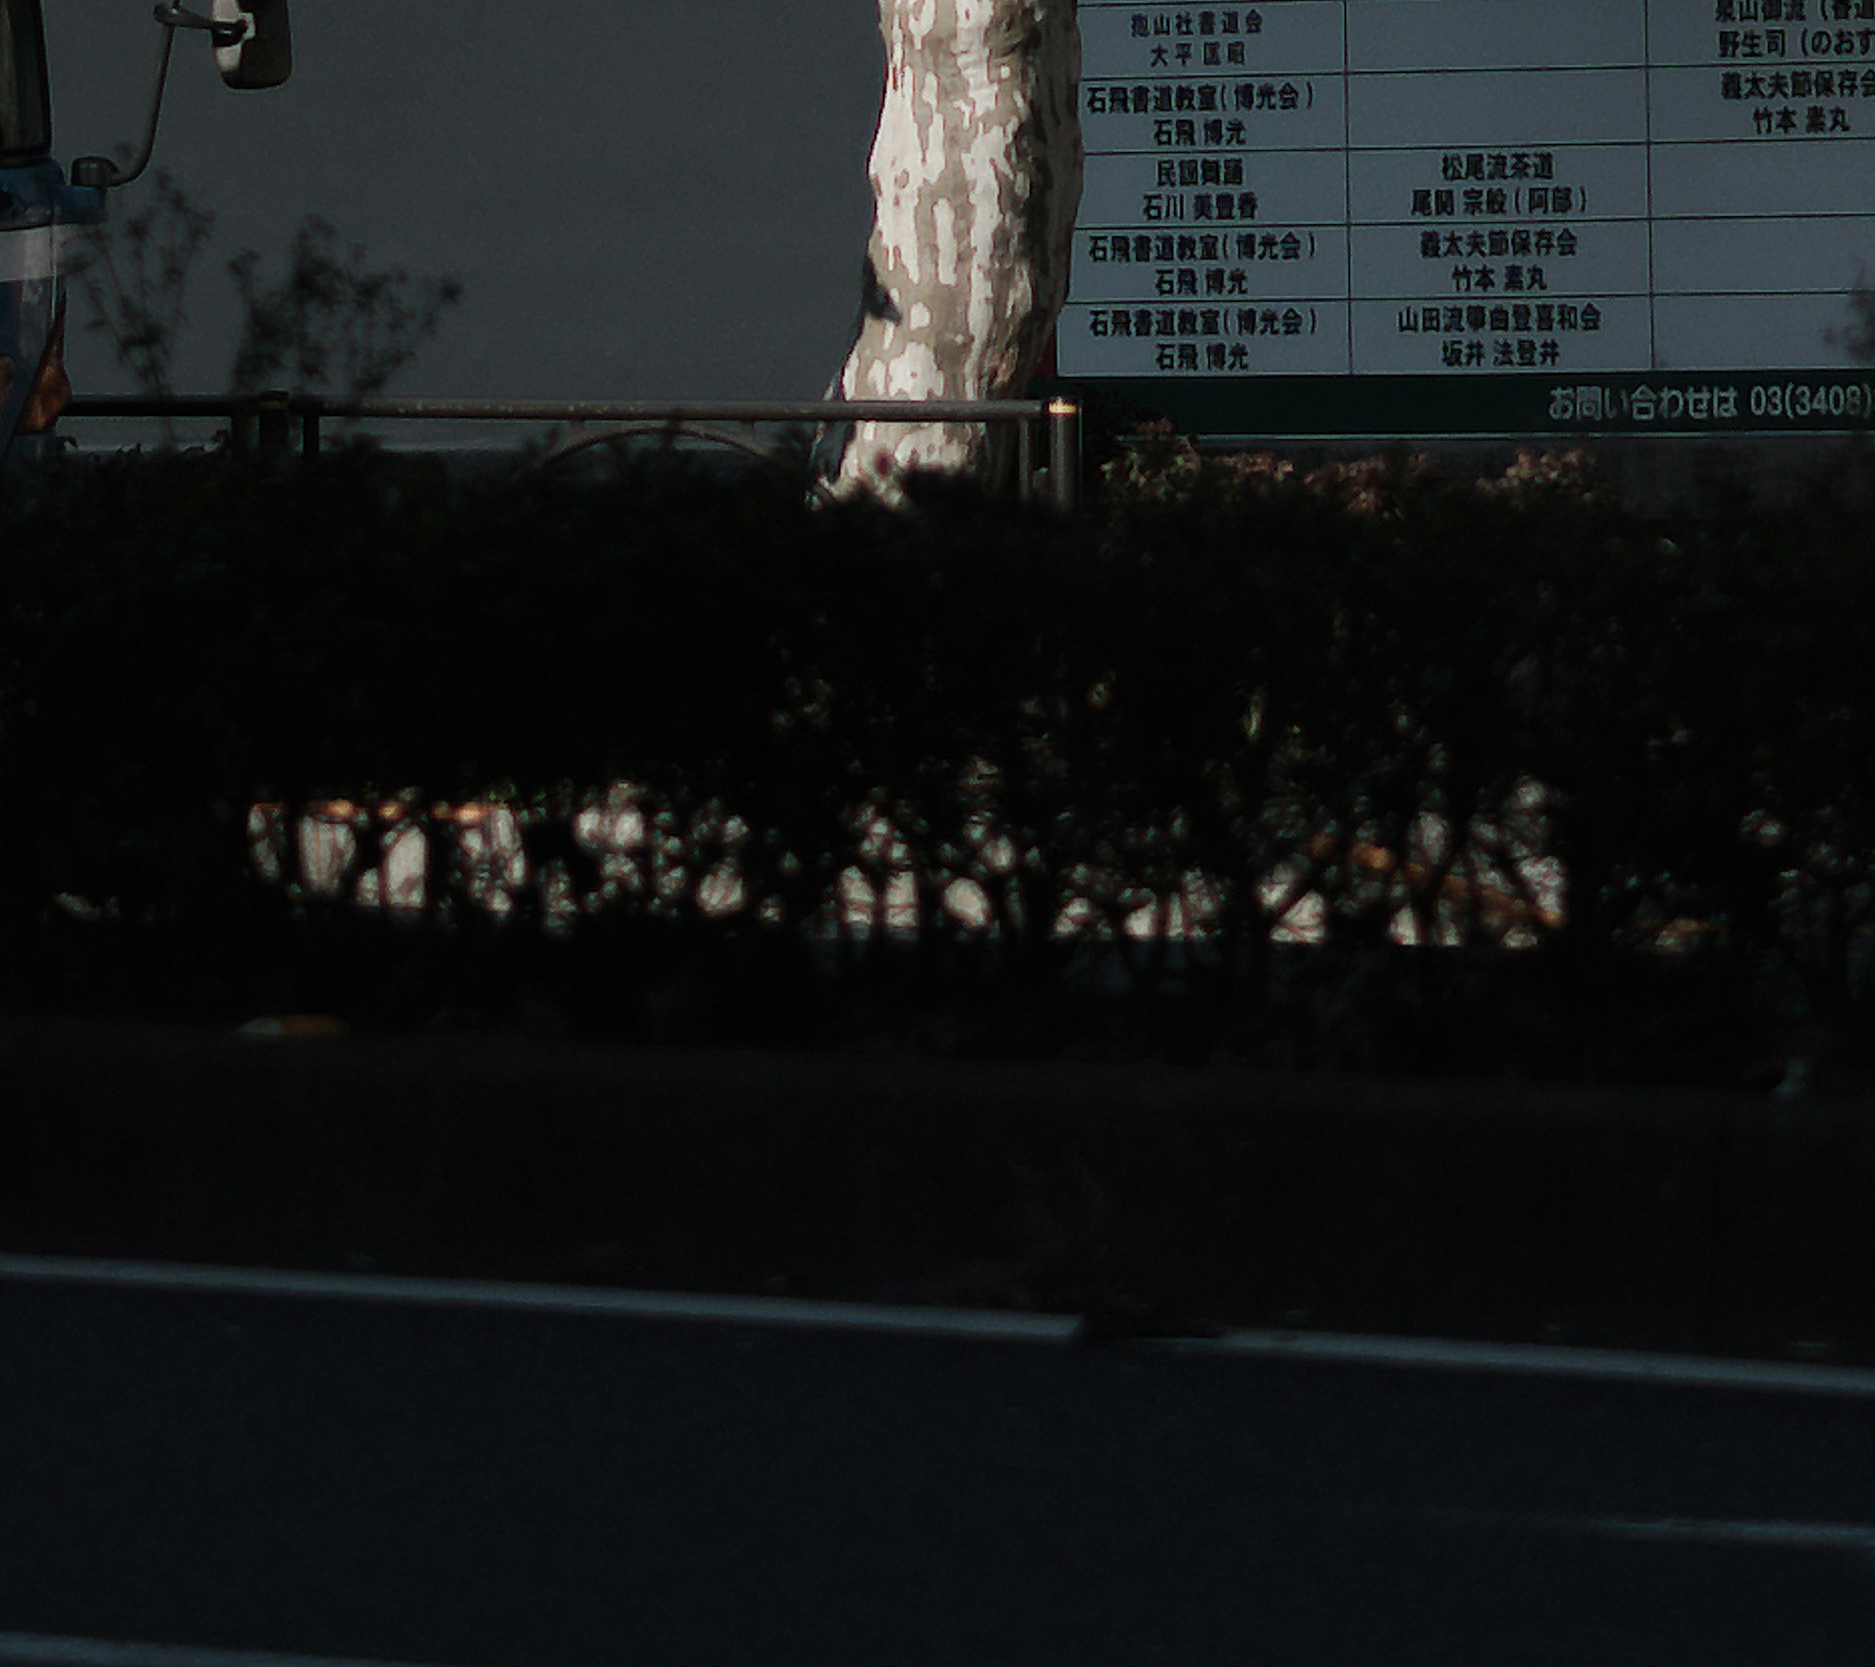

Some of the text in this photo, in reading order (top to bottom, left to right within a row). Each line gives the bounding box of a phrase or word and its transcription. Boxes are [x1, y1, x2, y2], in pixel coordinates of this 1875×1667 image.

[1753, 106, 1796, 134] 竹本
[1143, 193, 1184, 222] 石川
[1452, 265, 1495, 292] 竹本
[1549, 385, 1737, 420] お問い合わせは
